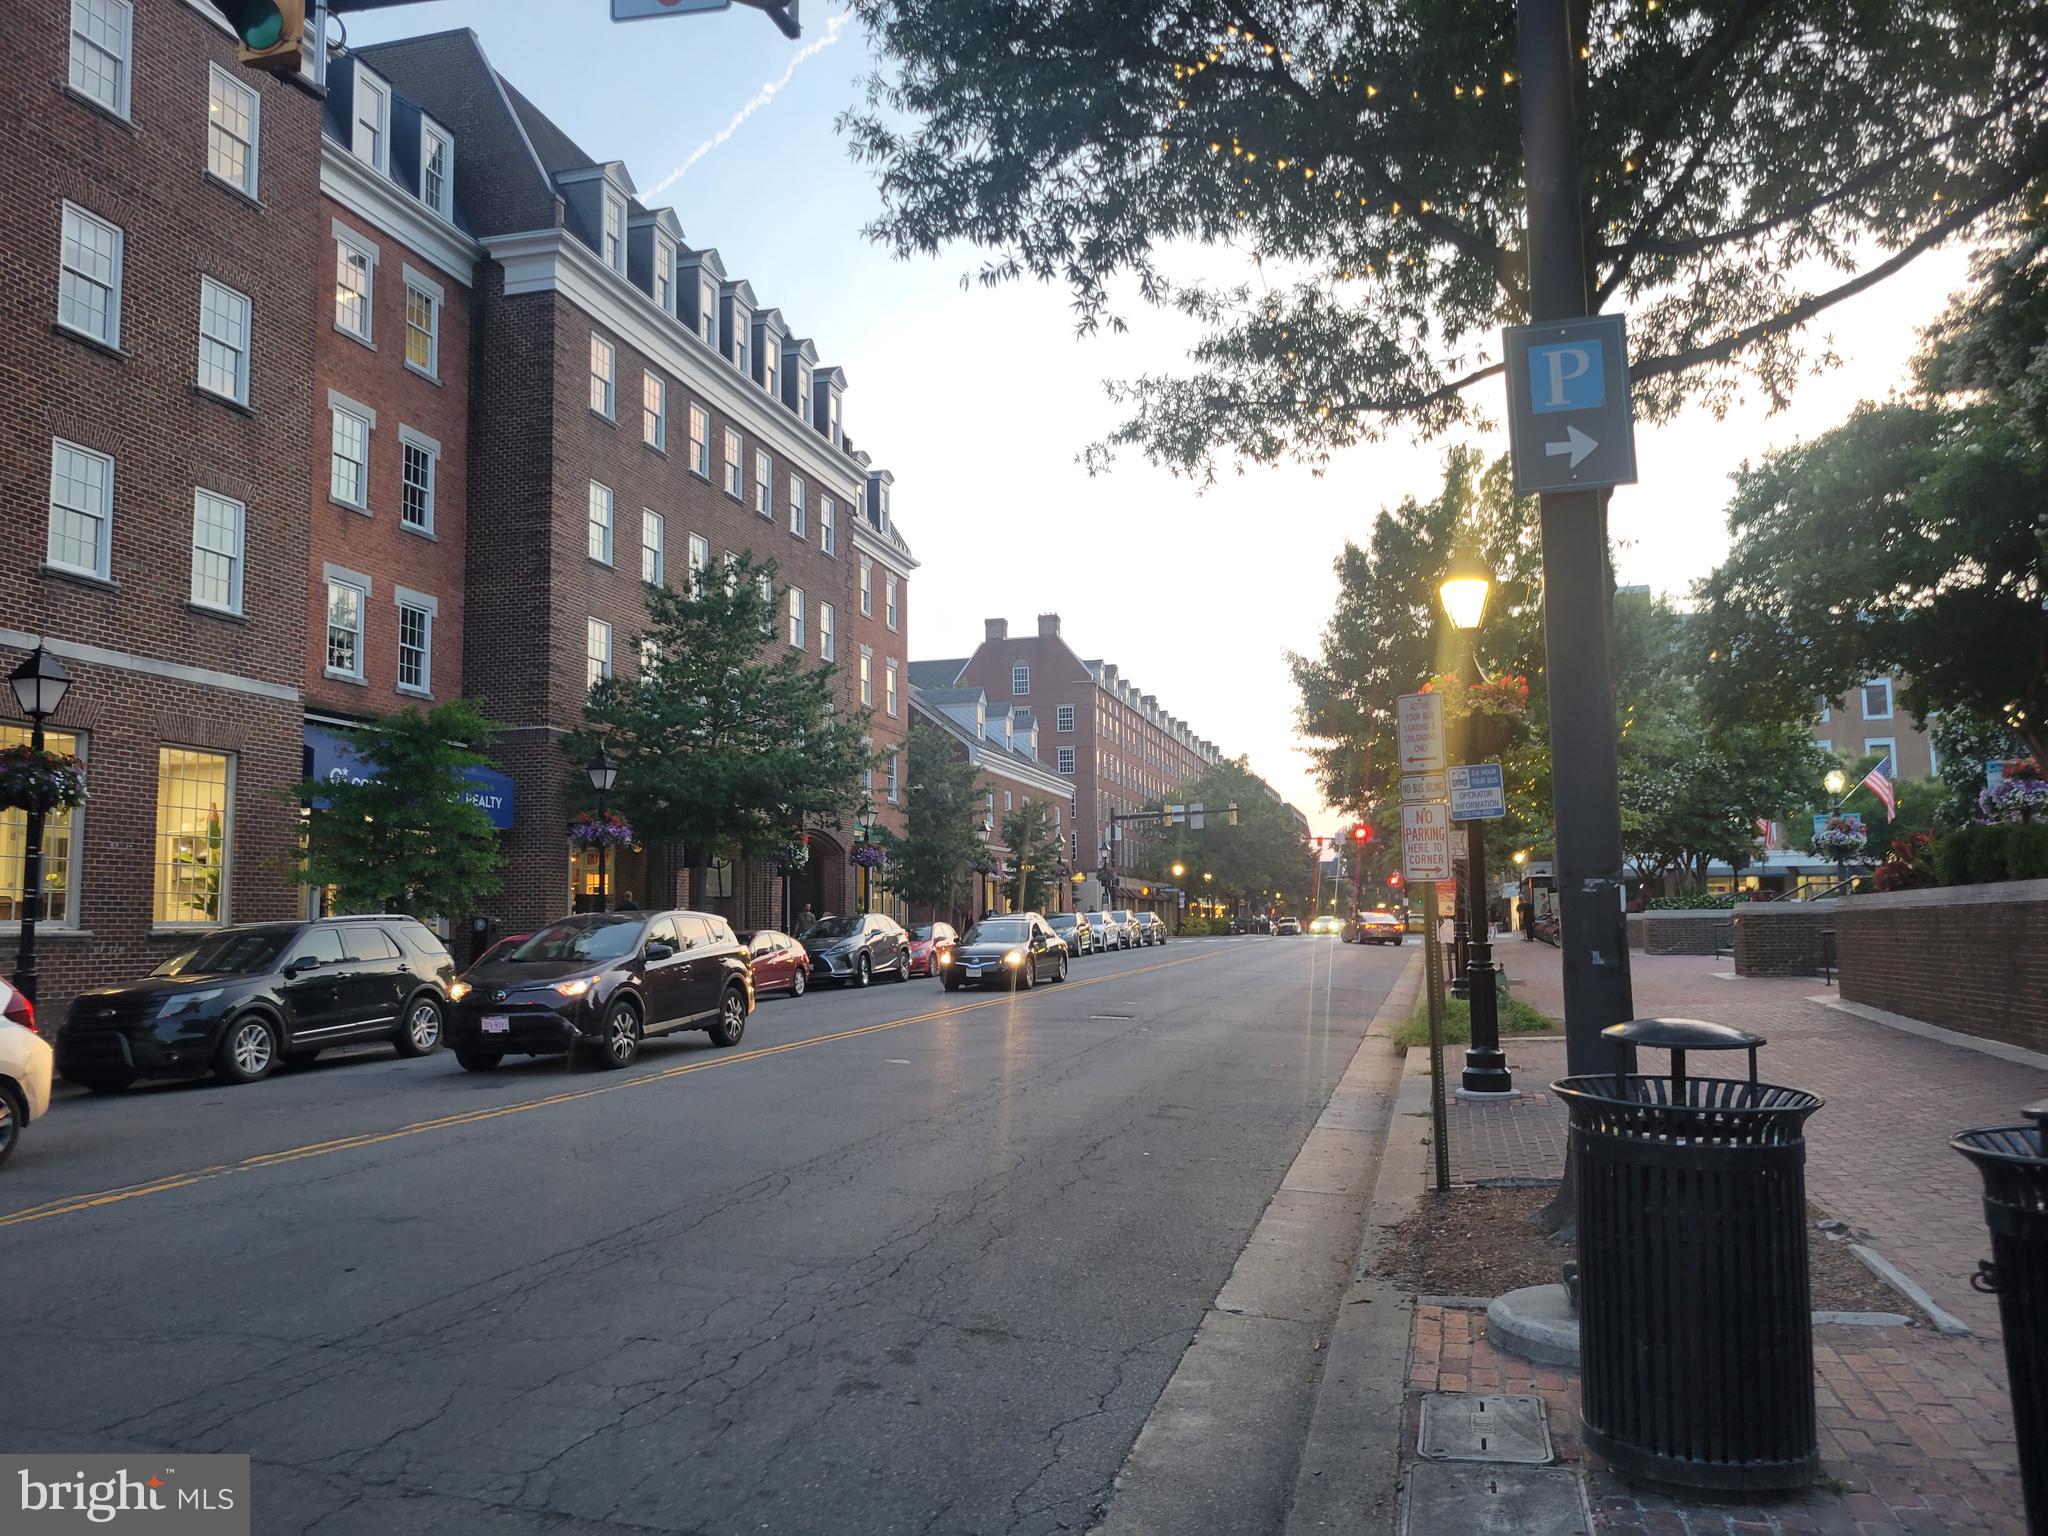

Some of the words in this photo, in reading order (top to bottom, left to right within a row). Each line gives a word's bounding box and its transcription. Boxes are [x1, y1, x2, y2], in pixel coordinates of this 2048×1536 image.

[1541, 348, 1590, 407] P
[1406, 712, 1420, 722] TOUR
[1423, 712, 1434, 720] BUS
[1404, 723, 1430, 732] LOADING
[1414, 744, 1428, 752] ONLY
[1481, 768, 1497, 776] HOUR
[1402, 784, 1411, 794] NO
[1413, 783, 1424, 793] BUS
[1459, 791, 1493, 800] OPERATOR
[1456, 800, 1499, 810] INFORMATION
[1416, 810, 1433, 824] NO
[1405, 827, 1445, 842] PARKING
[1408, 843, 1430, 853] HERE
[1433, 843, 1442, 853] TO
[1409, 855, 1444, 865] CORNER
